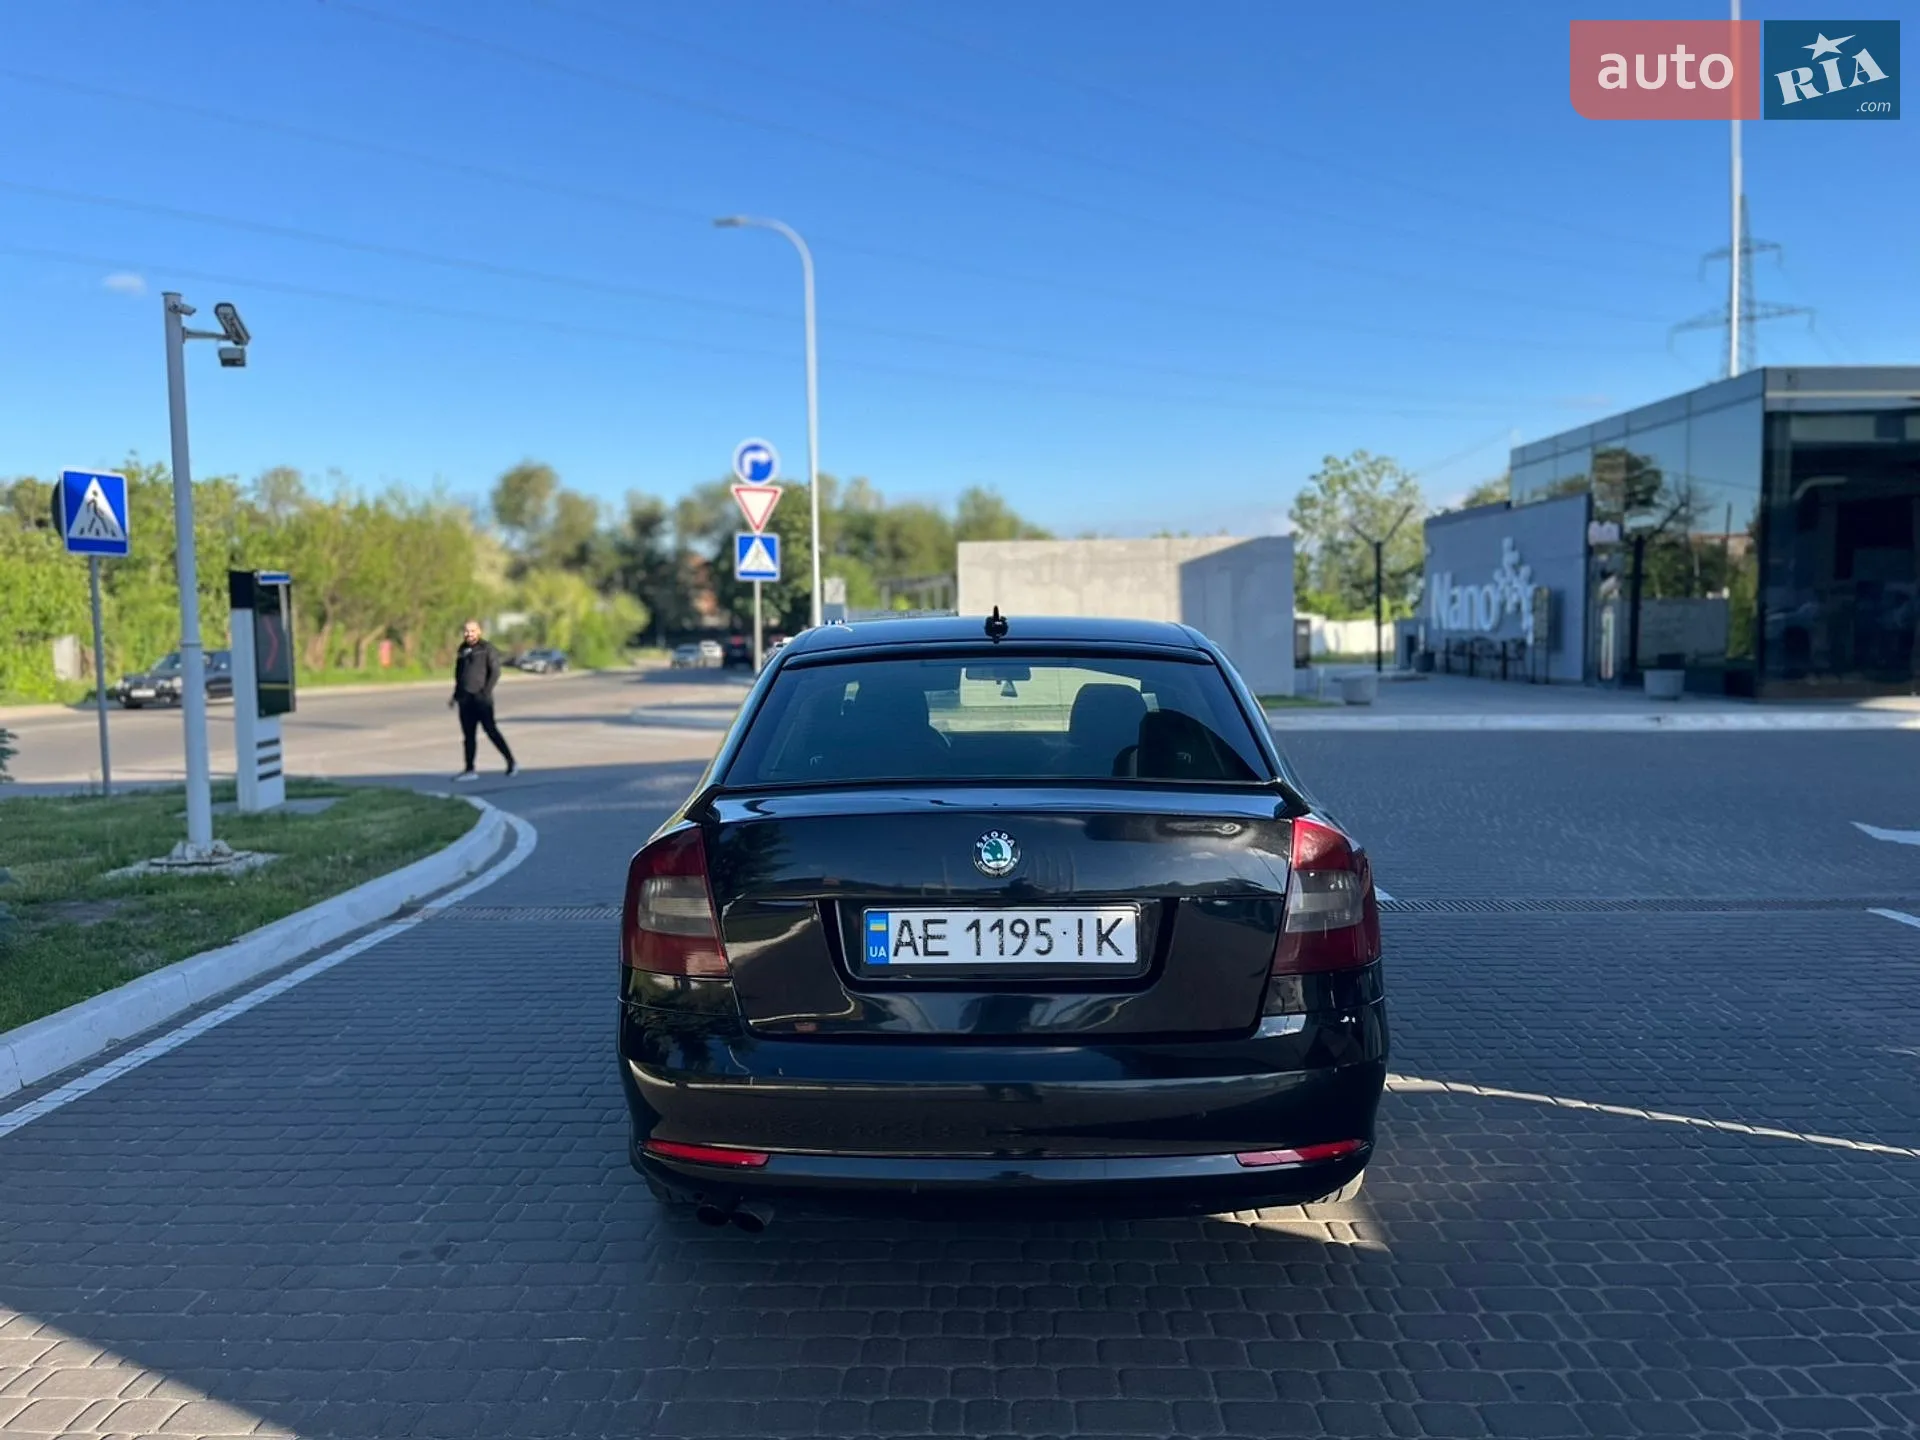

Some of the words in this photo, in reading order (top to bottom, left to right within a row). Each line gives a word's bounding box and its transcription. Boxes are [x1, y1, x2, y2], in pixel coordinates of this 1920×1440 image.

[1430, 571, 1499, 632] Nano
[869, 945, 887, 958] UA
[893, 918, 949, 957] AE
[965, 918, 1054, 957] 1195
[1077, 917, 1125, 957] IK
